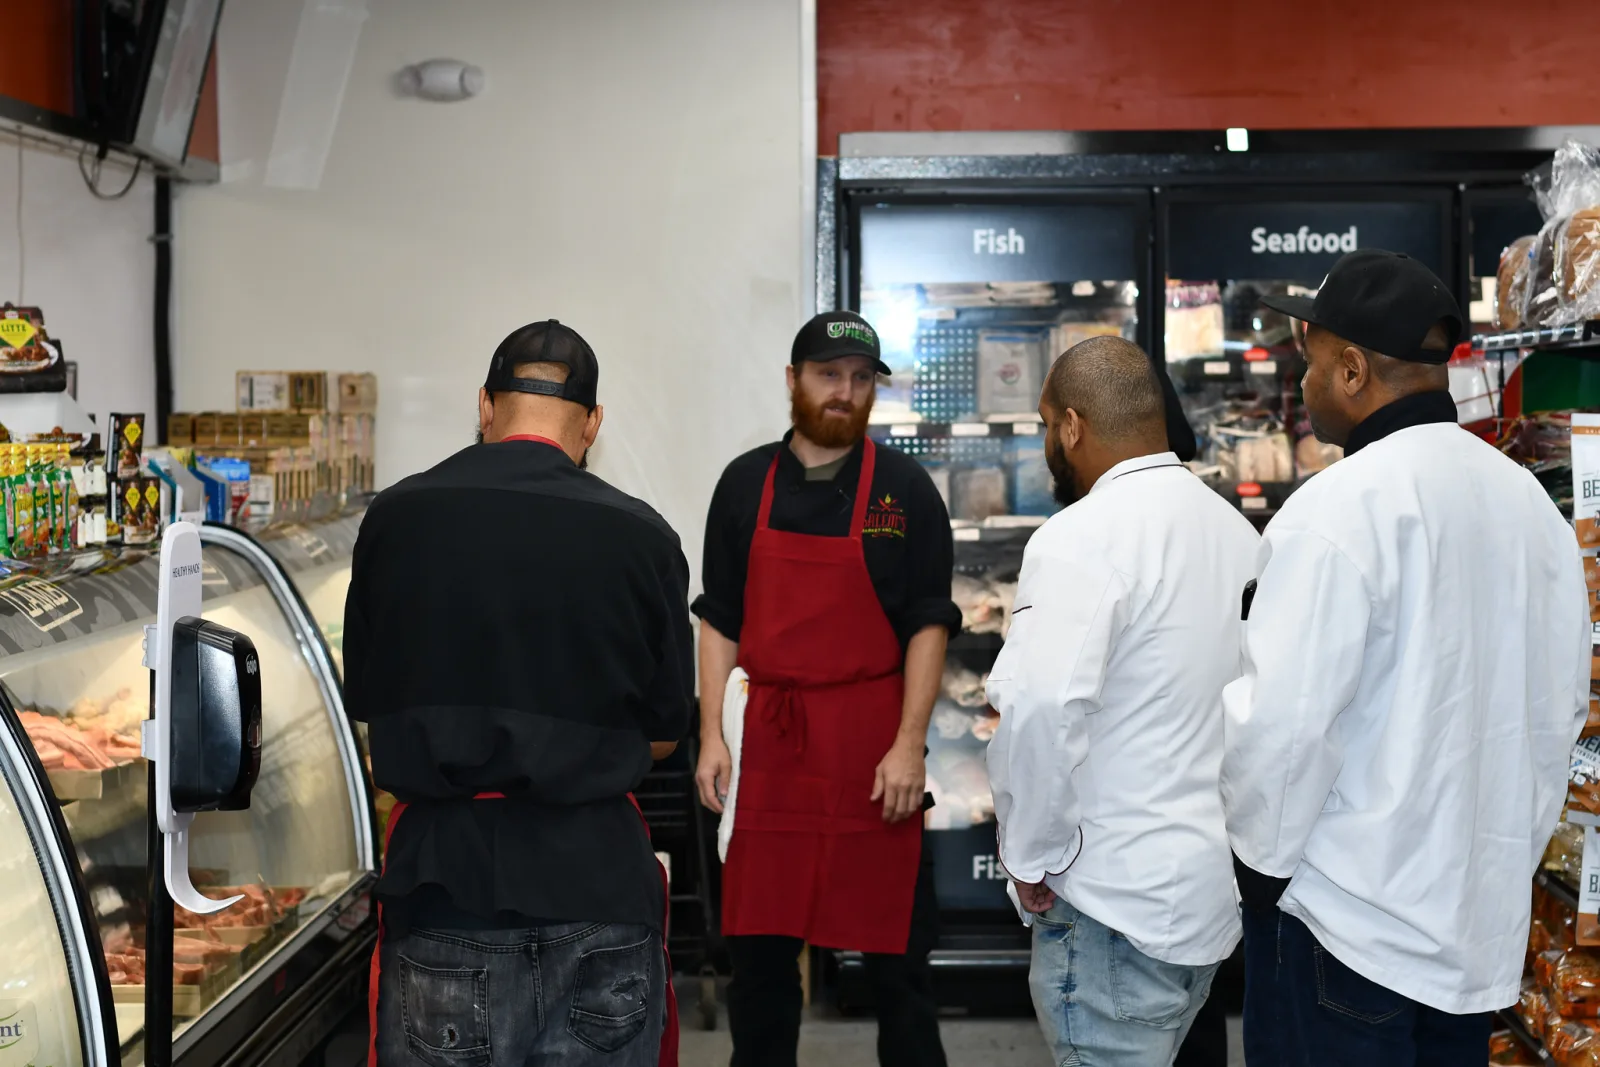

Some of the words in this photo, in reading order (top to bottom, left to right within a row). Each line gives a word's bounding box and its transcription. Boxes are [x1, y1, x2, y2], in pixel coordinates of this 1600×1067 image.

[973, 228, 1025, 255] Fish
[1251, 225, 1357, 253] Seafood
[973, 854, 1007, 880] Fis
